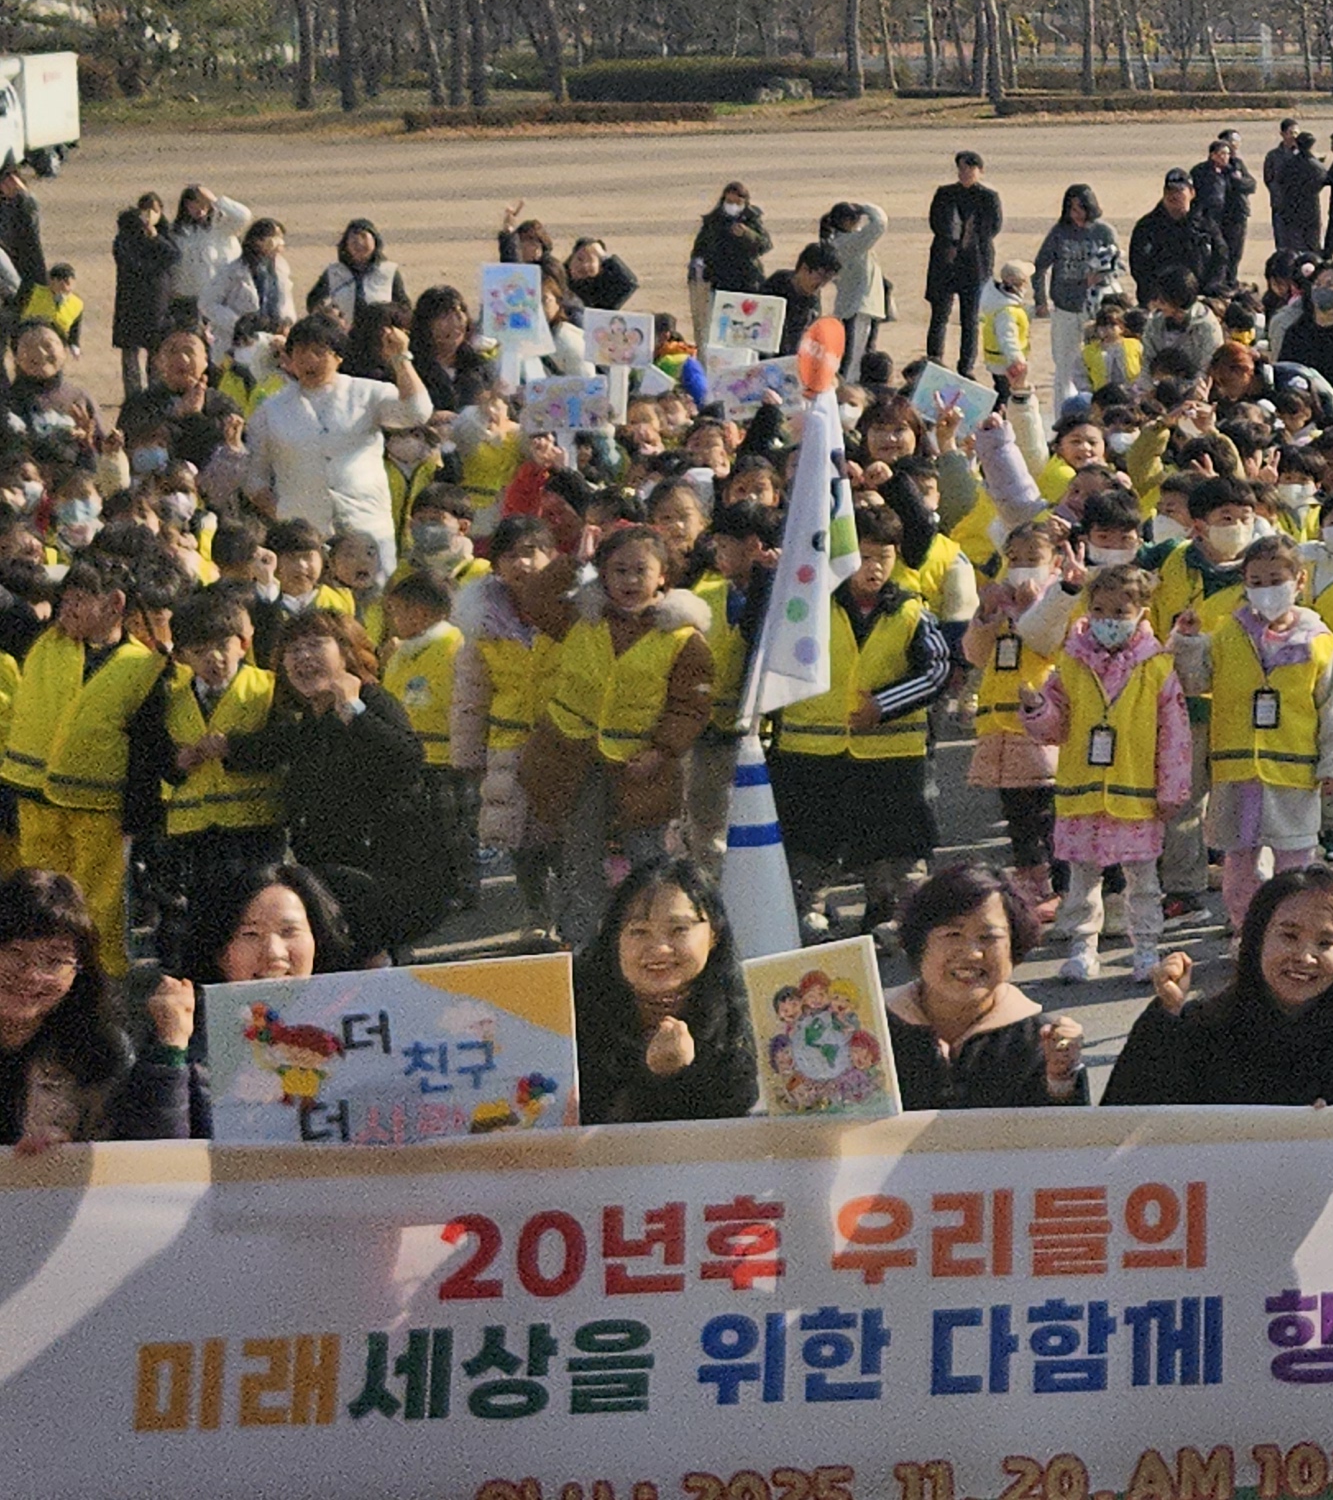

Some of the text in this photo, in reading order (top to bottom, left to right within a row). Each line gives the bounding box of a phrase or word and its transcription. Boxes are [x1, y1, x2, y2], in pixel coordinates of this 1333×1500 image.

[342, 1008, 497, 1094] 더 친구
[437, 1180, 1208, 1301] 20년후 우리들의
[696, 1304, 891, 1406] 위한
[930, 1294, 1224, 1397] 다함께
[1127, 1445, 1234, 1500] AM
